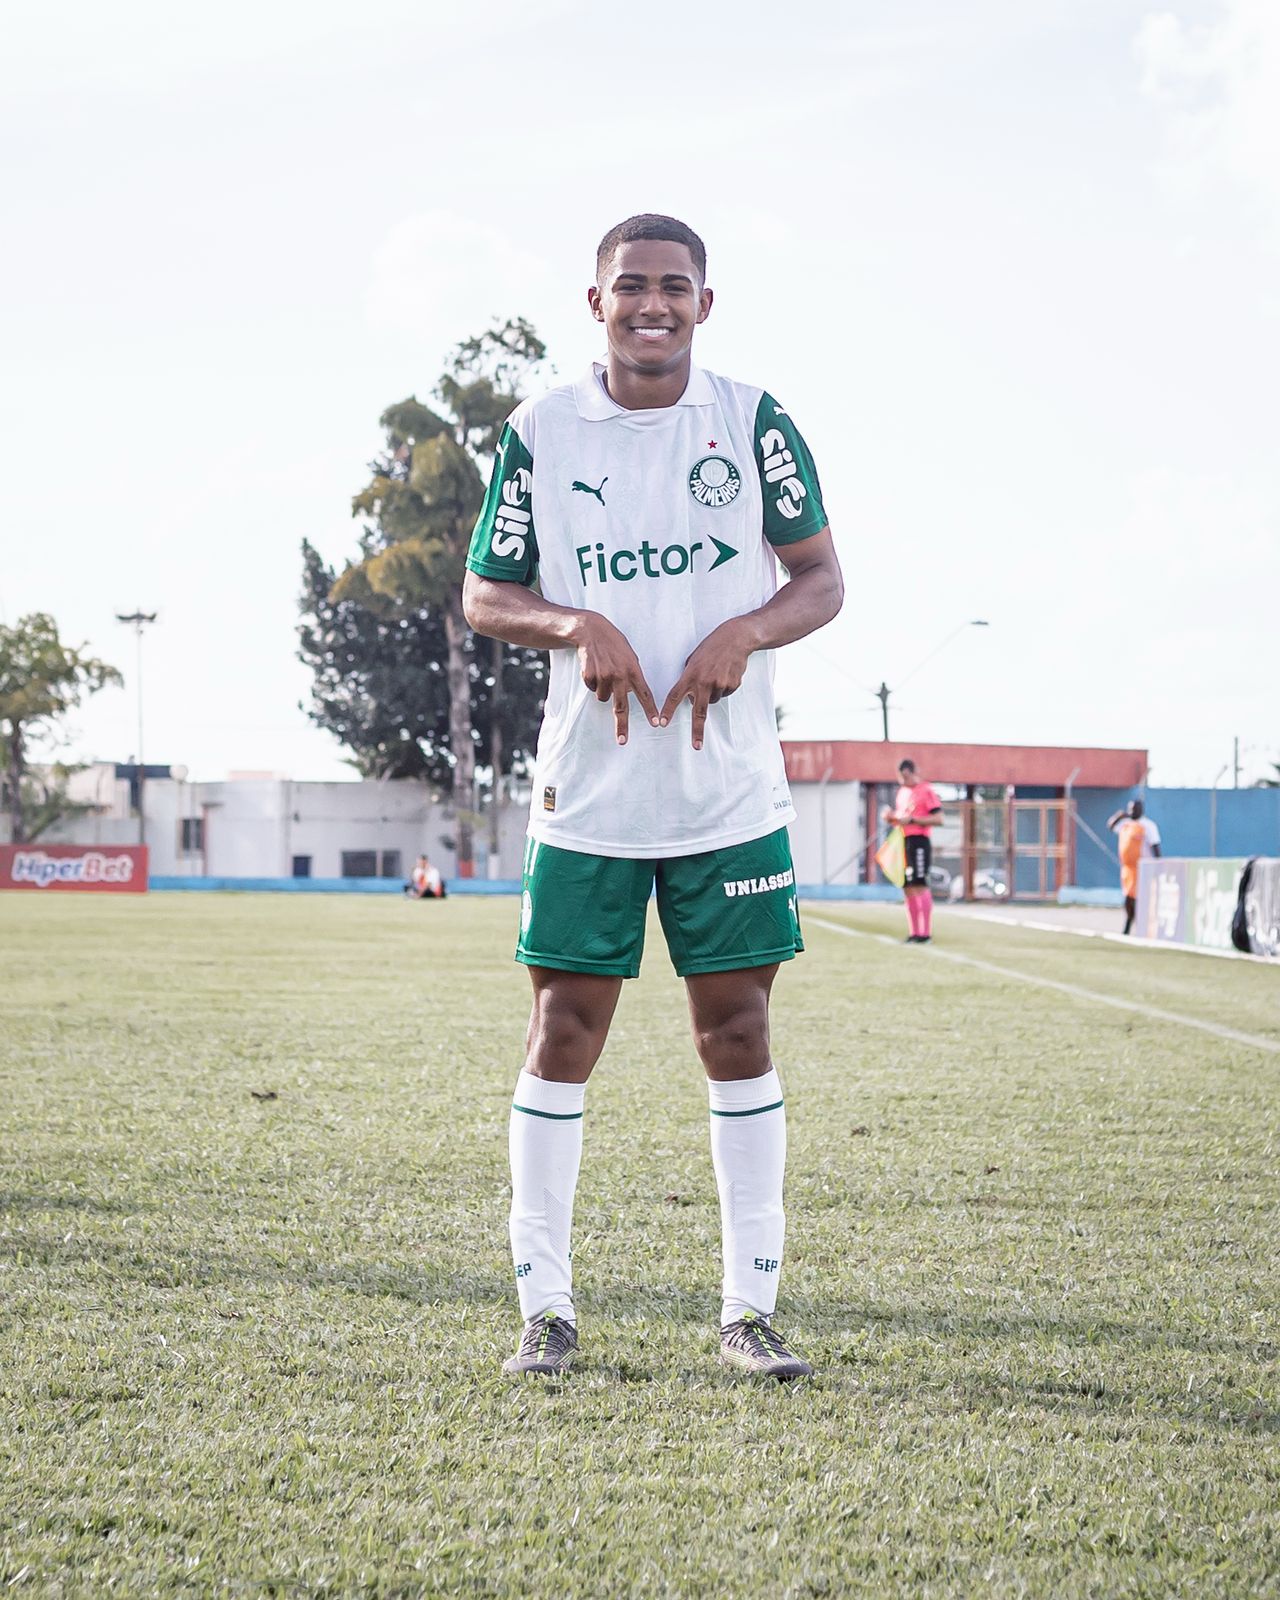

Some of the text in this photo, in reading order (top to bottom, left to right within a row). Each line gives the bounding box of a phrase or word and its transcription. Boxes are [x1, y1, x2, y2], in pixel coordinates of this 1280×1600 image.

[690, 477, 740, 506] PALMEIRAS
[576, 540, 703, 587] Fictor
[14, 853, 132, 886] HiperBet
[754, 1257, 778, 1273] SEP
